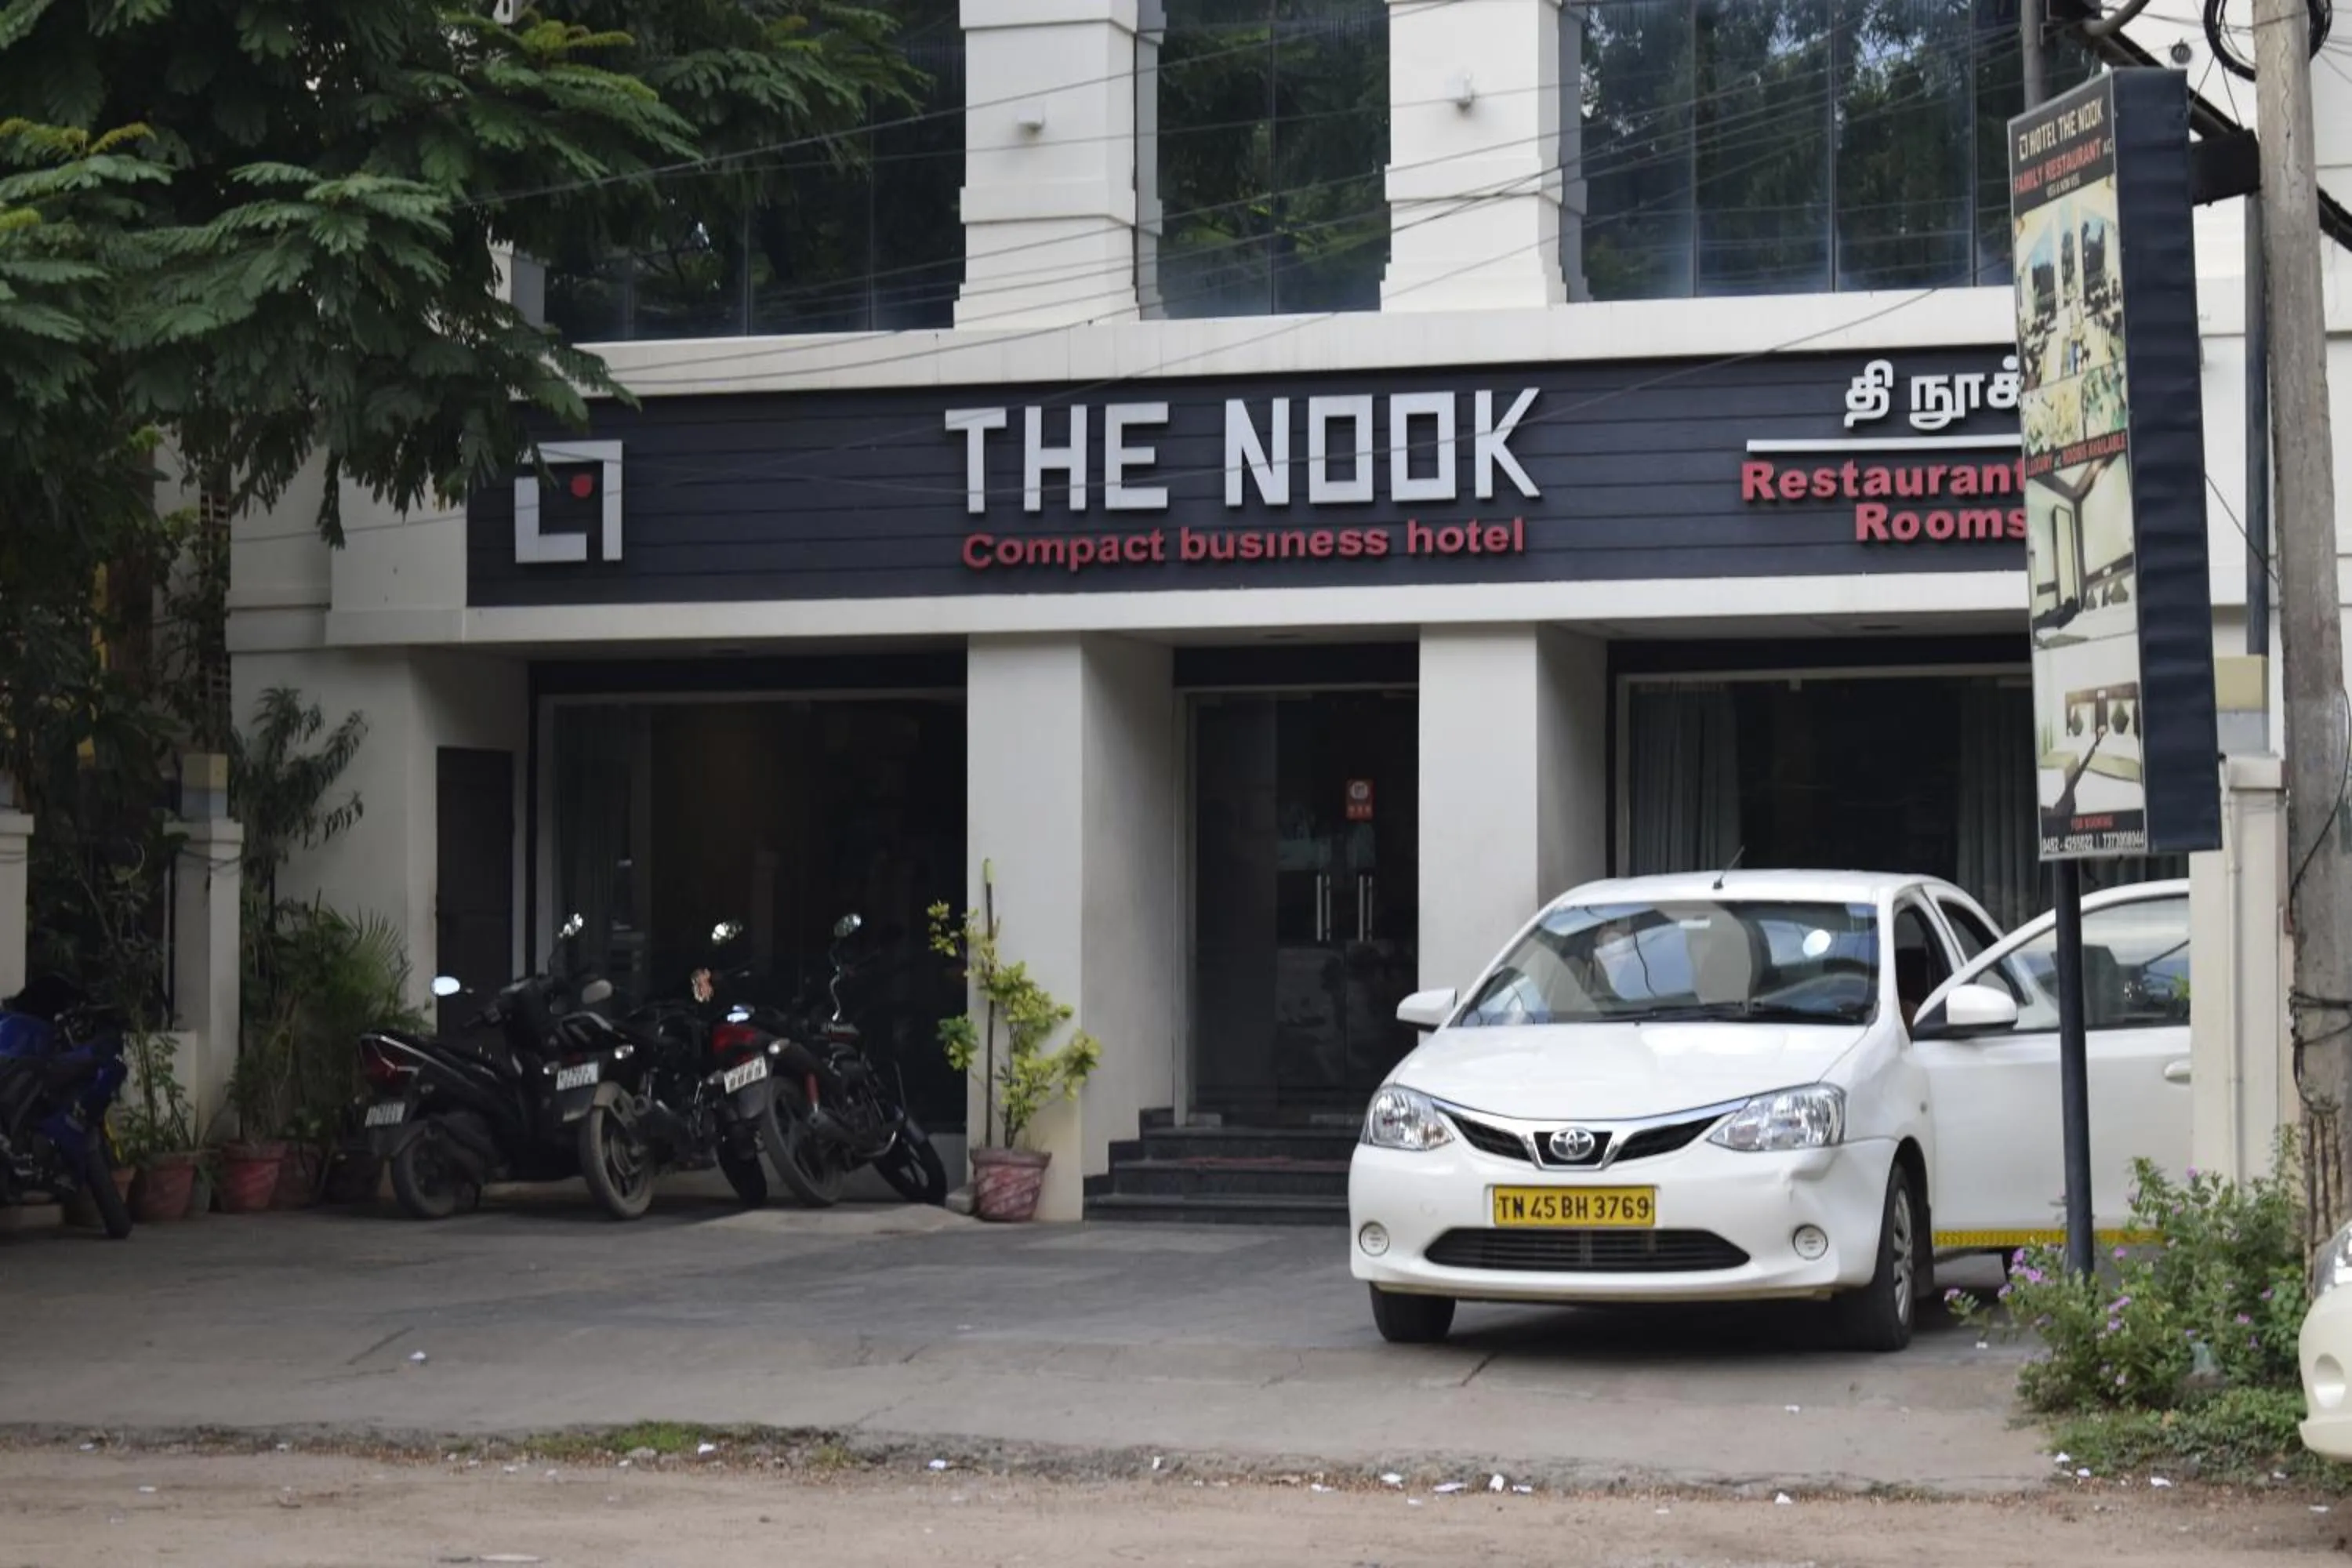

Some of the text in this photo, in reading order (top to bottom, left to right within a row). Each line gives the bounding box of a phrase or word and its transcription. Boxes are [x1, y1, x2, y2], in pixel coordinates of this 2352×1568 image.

[2029, 98, 2104, 157] HOTEL THE NOOK
[945, 387, 1541, 514] THE NOOK
[1741, 459, 2026, 501] Restaurant
[961, 517, 1525, 572] Compact business hotel
[1855, 503, 2028, 542] Rooms
[1499, 1196, 1650, 1220] TN 45 BH 3769
